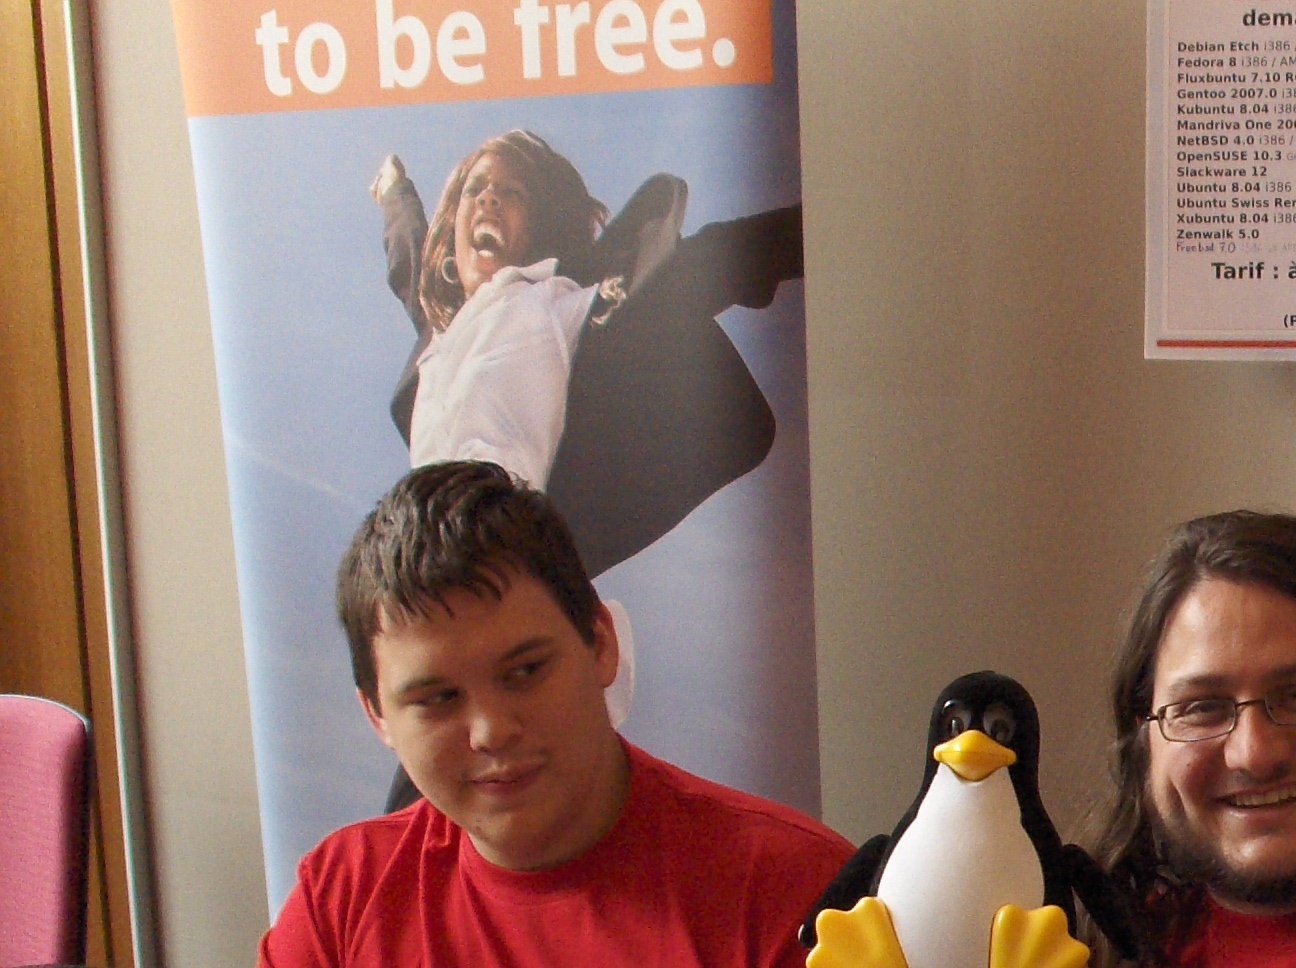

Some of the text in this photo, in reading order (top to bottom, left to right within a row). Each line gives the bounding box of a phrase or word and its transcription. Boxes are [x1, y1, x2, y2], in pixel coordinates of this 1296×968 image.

[255, 0, 736, 96] to be free.
[1178, 41, 1225, 51] Debian
[1230, 41, 1258, 51] Etch
[1264, 41, 1290, 51] i386
[1178, 57, 1223, 67] Fedora
[1229, 57, 1236, 67] 8
[1242, 57, 1267, 67] i386
[1178, 73, 1245, 83] Fluxbuntu
[1251, 73, 1280, 83] 7.10
[1178, 88, 1226, 99] Gentoo
[1231, 88, 1277, 99] 2007.0
[1178, 104, 1234, 114] Kubuntu
[1240, 104, 1269, 114] 8.04
[1178, 120, 1240, 130] Mandriva
[1245, 120, 1272, 130] One
[1177, 135, 1228, 146] NetBSD
[1233, 135, 1254, 146] 4.0
[1259, 135, 1285, 146] i386
[1177, 151, 1282, 162] OpenSUSE 10.3
[1177, 167, 1267, 177] Slackware 12
[1177, 183, 1226, 193] Ubuntu
[1232, 183, 1260, 193] 8.04
[1266, 183, 1291, 193] i386
[1177, 198, 1226, 208] Ubuntu
[1232, 198, 1269, 208] Swiss
[1177, 214, 1234, 224] Xubuntu
[1240, 214, 1268, 224] 8.04
[1177, 229, 1259, 239] Zenwalk 5.0
[1212, 262, 1265, 279] Tarif
